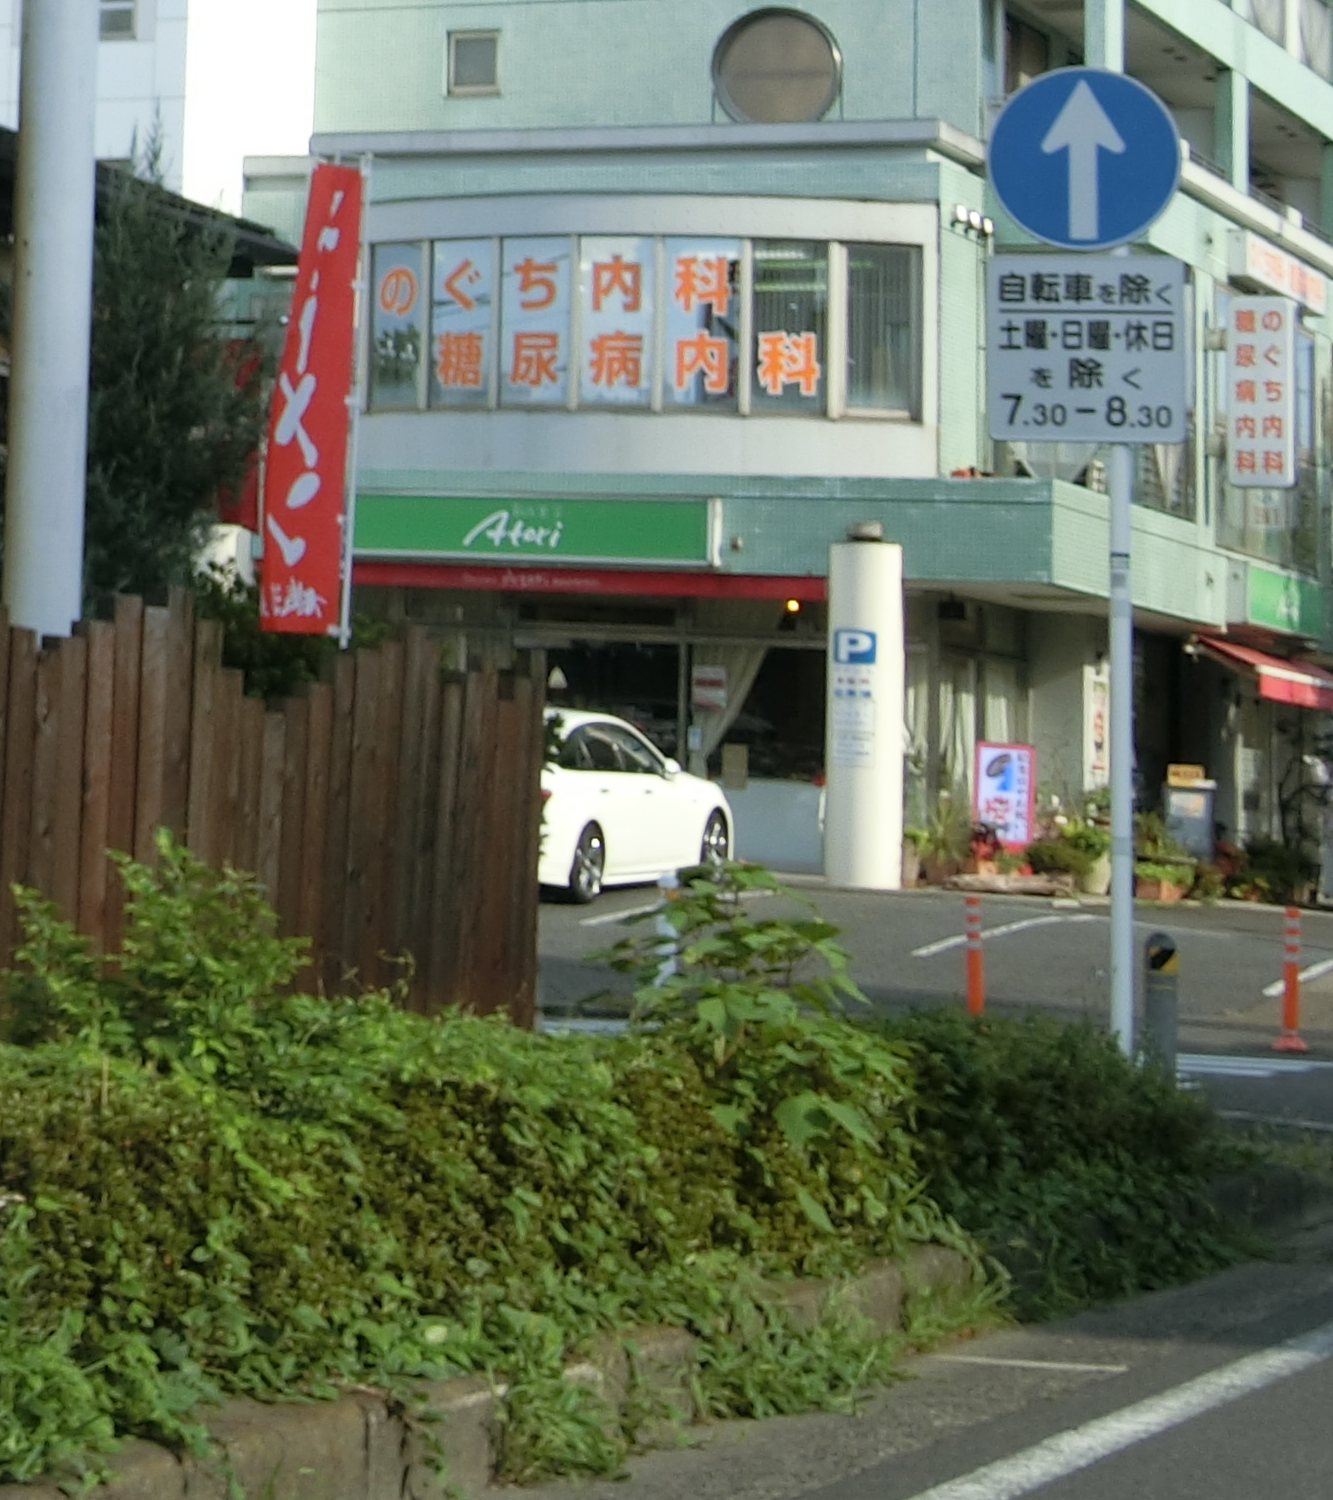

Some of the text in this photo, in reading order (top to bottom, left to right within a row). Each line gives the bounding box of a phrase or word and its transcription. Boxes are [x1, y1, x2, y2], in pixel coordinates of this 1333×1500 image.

[379, 253, 731, 317] のぐち内科
[998, 271, 1173, 305] 自転車を除く
[436, 329, 822, 397] 糖尿病内科
[1029, 356, 1144, 391] を除く
[1262, 309, 1285, 475] のぐち内科
[837, 631, 873, 663] P
